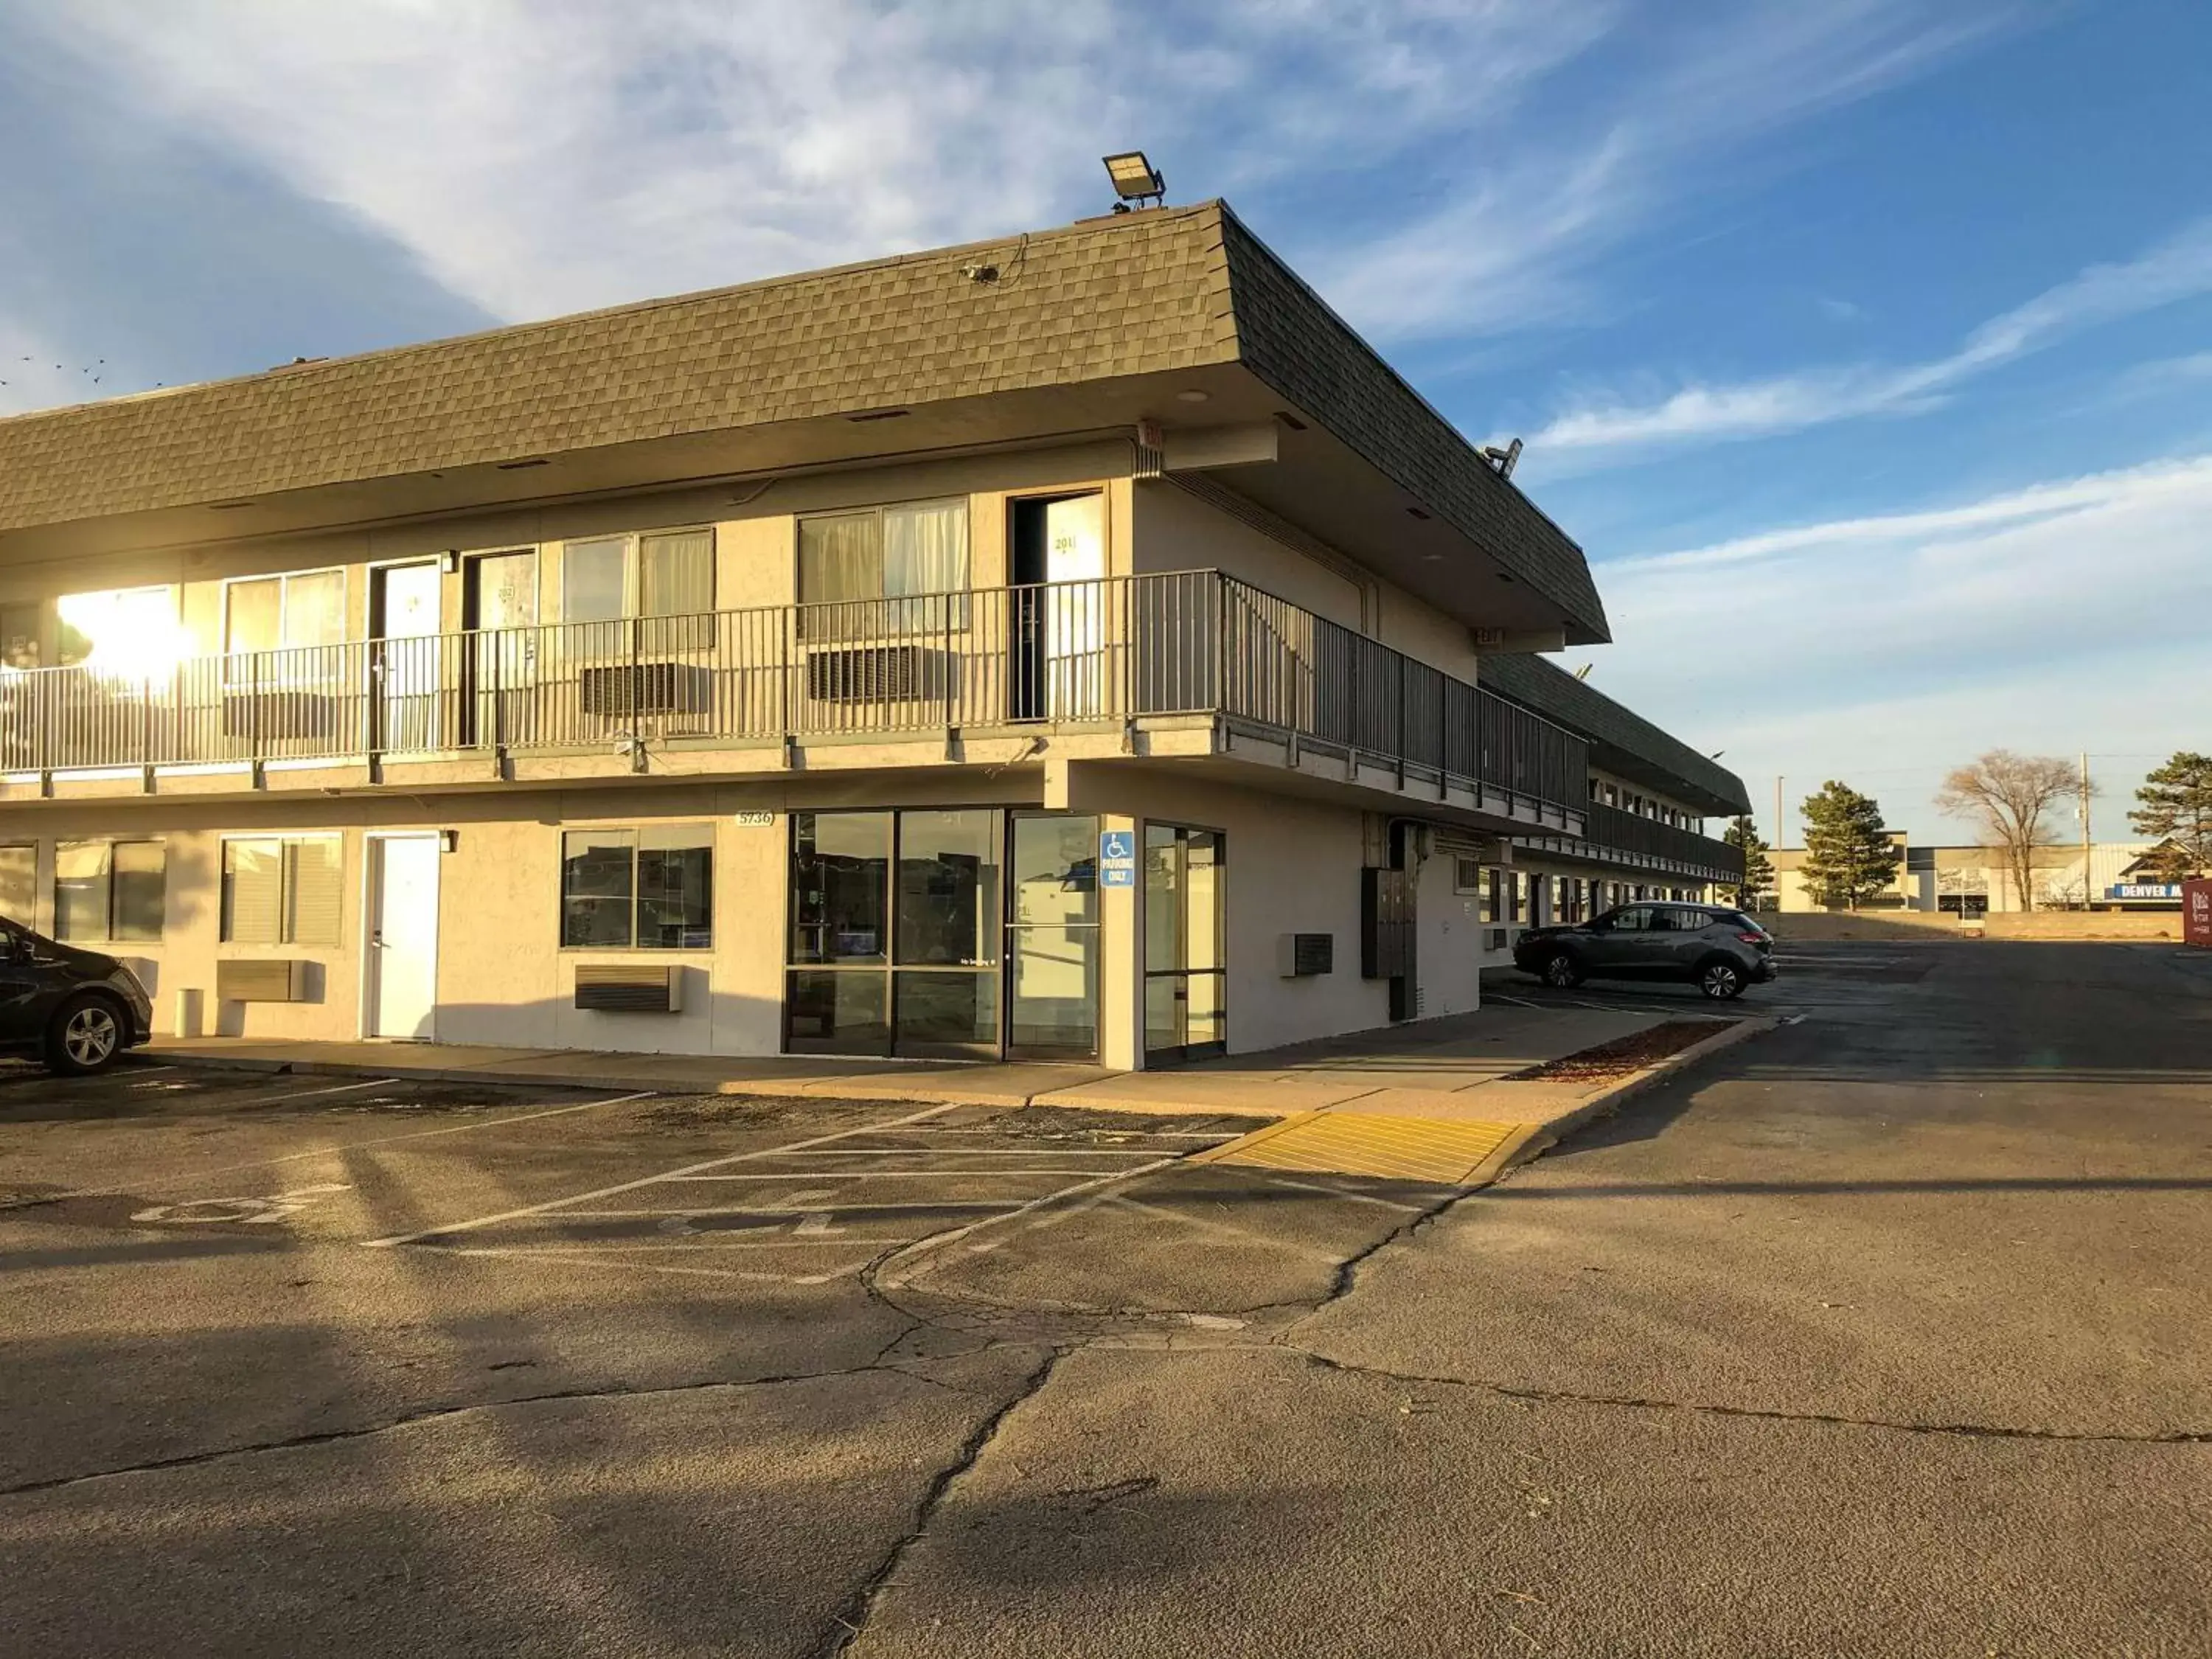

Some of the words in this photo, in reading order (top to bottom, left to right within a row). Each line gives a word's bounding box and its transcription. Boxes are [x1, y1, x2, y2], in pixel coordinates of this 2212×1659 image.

[1102, 858, 1133, 869] PARKING
[1108, 870, 1127, 881] ONLY
[2121, 885, 2166, 897] DENVER
[2171, 884, 2183, 897] M
